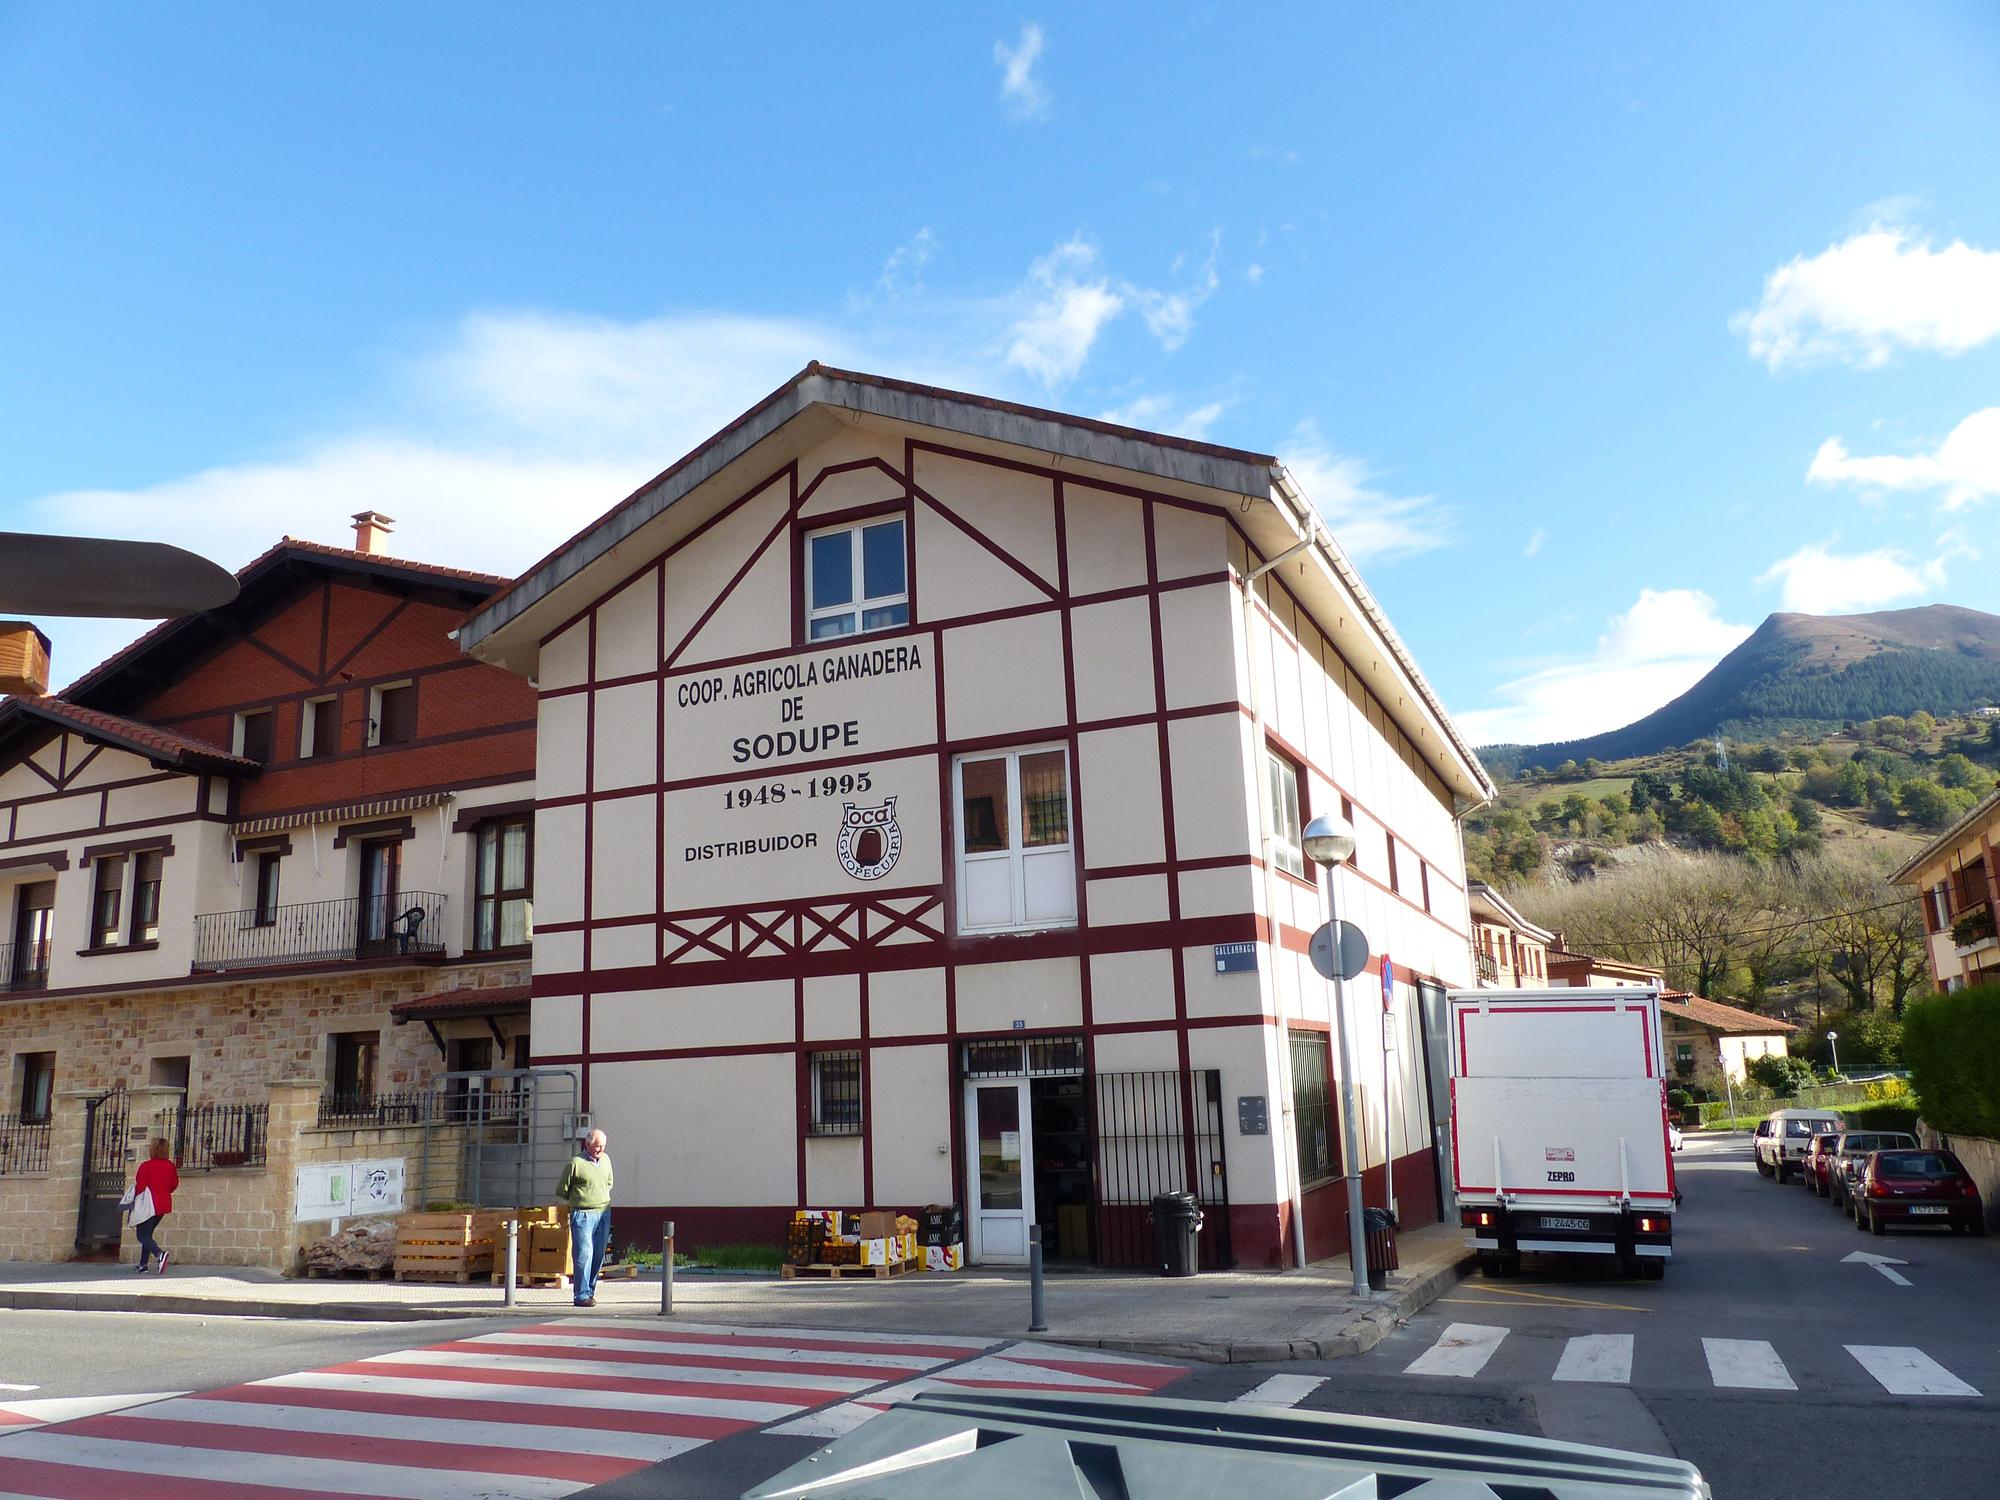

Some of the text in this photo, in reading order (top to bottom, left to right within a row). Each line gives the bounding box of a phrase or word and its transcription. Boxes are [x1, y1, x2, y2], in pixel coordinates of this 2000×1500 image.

[678, 644, 922, 708] COOP. AGRICOLA GANADERA
[781, 696, 804, 723] DE
[732, 720, 859, 763] SODUPE
[685, 832, 818, 862] DISTRIBUIDOR
[840, 823, 900, 878] AGROPECUARIA
[1547, 1171, 1575, 1182] ZEPRO
[1554, 1219, 1576, 1228] 2445
